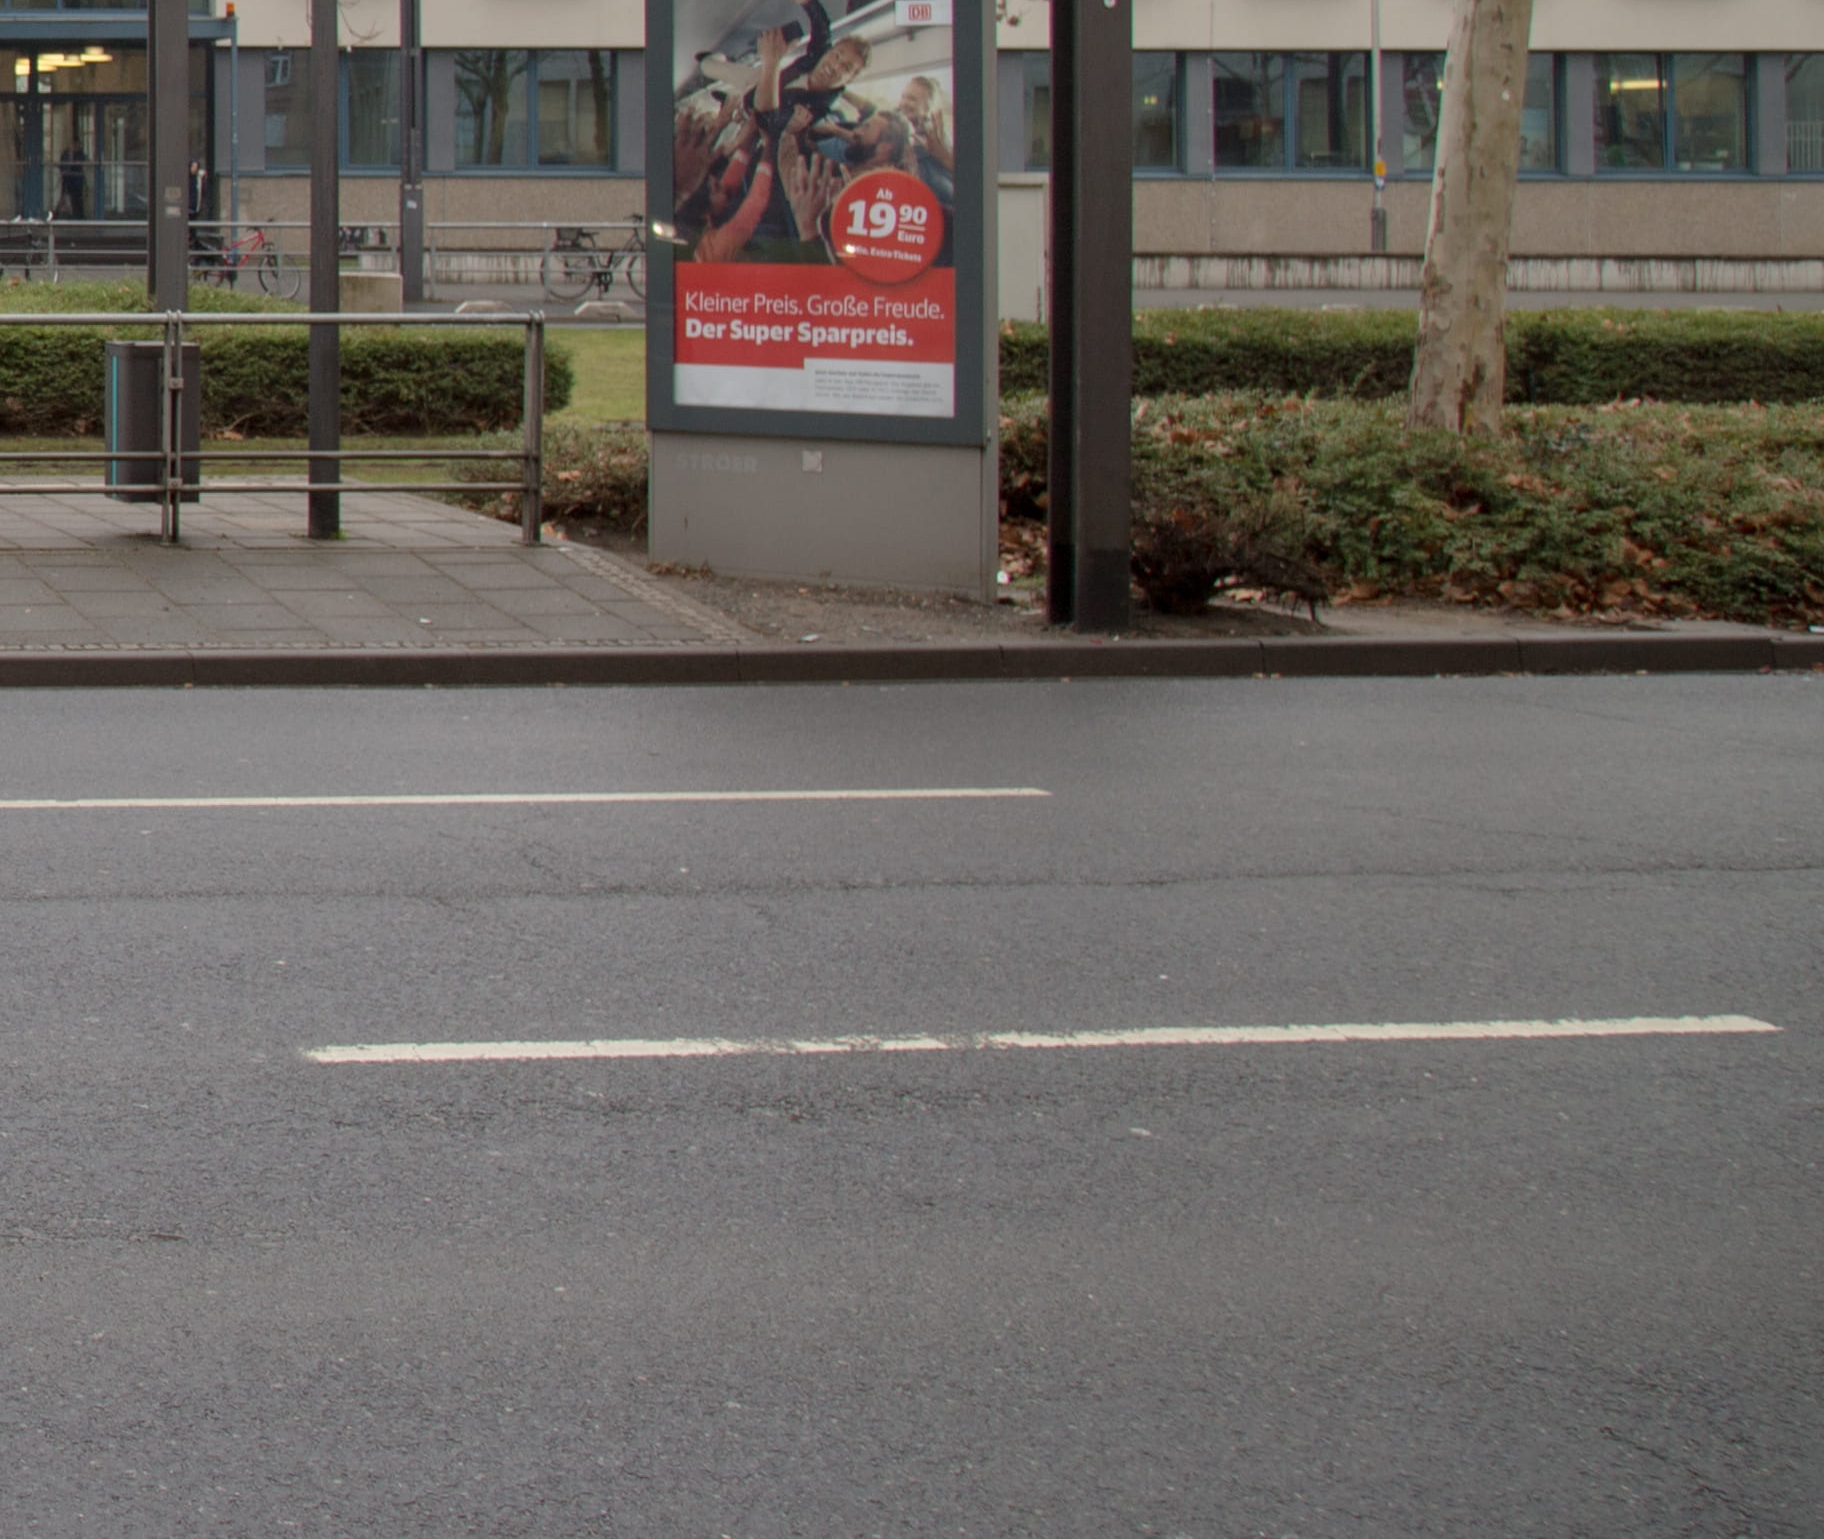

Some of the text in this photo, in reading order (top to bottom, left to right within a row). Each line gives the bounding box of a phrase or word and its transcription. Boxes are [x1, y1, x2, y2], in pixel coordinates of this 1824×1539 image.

[876, 188, 893, 200] Ab
[846, 199, 928, 238] 19 90
[897, 230, 925, 245] Euro
[685, 291, 945, 319] Kleiner Preis. Große Freude.
[685, 318, 914, 348] Der Super Sparpreis.
